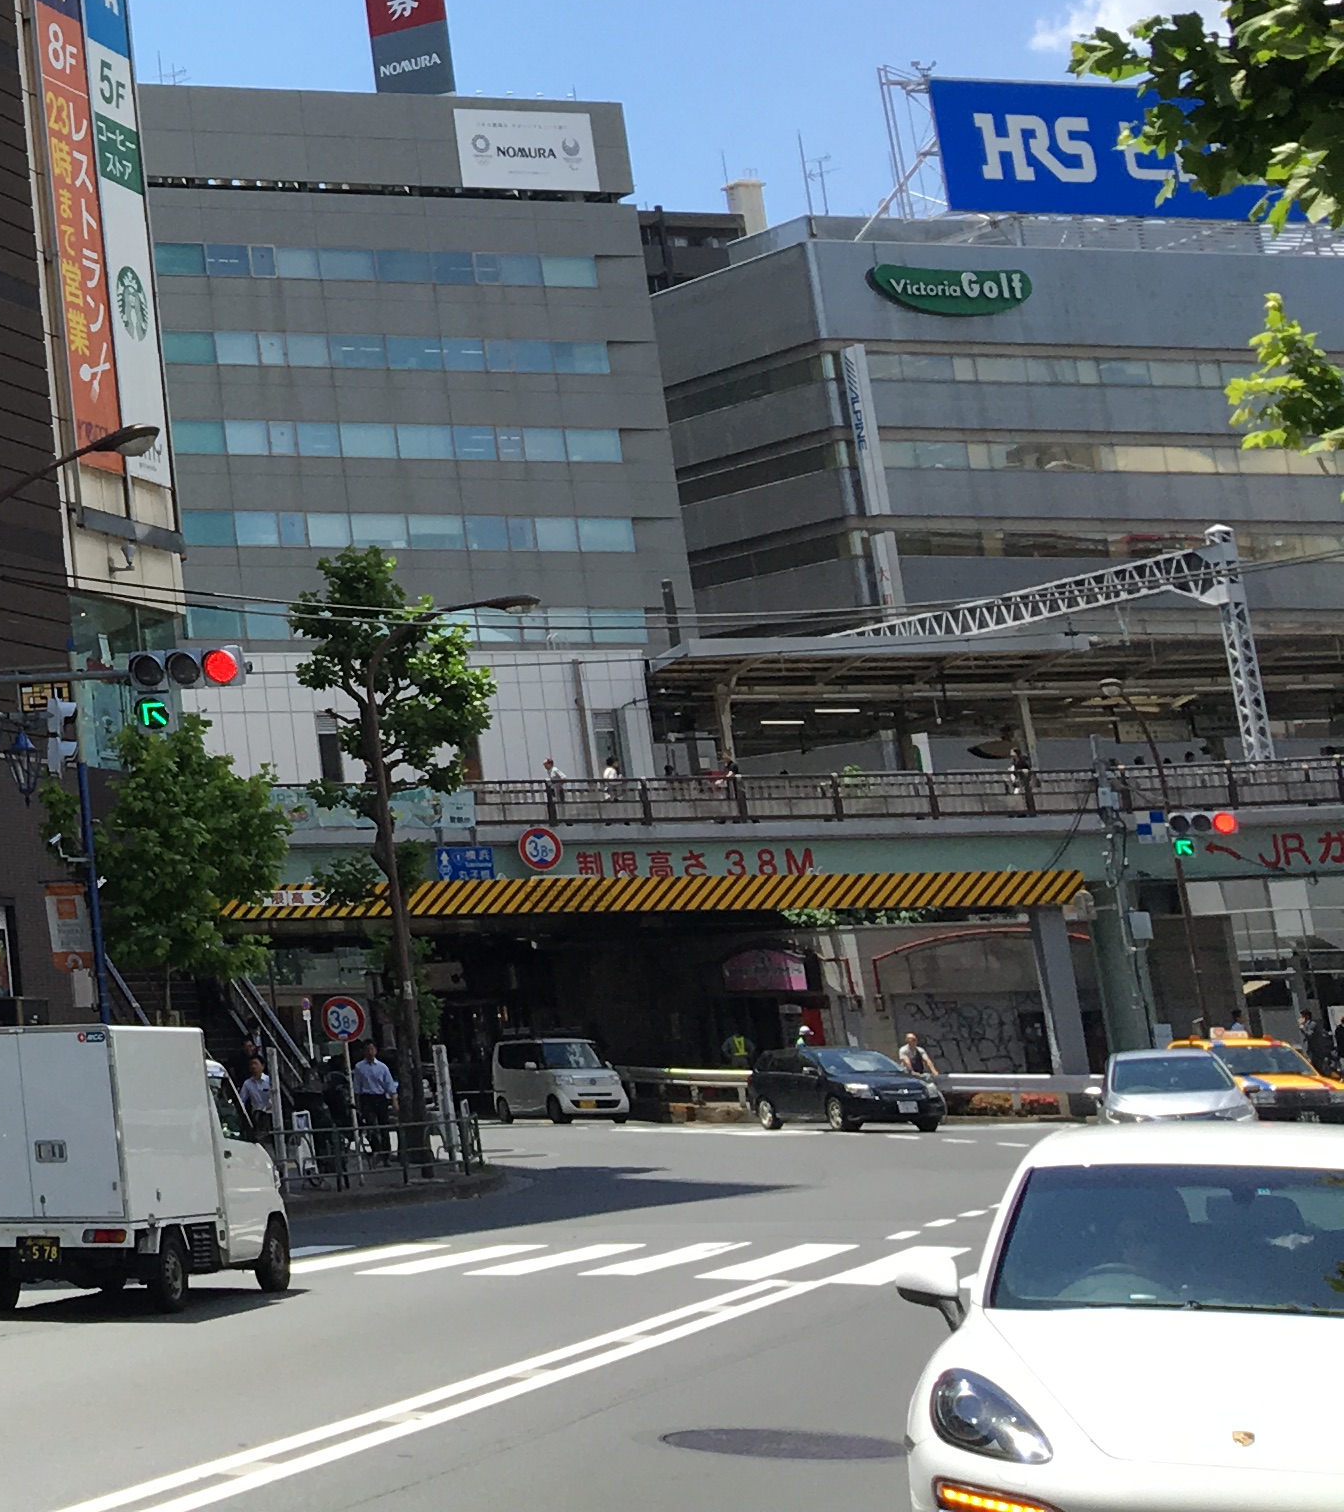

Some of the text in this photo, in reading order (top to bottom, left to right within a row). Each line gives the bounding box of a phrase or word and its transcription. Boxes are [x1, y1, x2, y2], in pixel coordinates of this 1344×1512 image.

[46, 21, 79, 76] 8F
[379, 52, 442, 78] NOMURA
[98, 58, 127, 111] 5F
[97, 121, 137, 152] コーヒー
[496, 145, 558, 160] NOMURA
[972, 112, 1098, 184] HRS
[103, 152, 133, 183] ストア
[45, 90, 91, 357] 23時まで営業
[67, 101, 107, 333] レストラン
